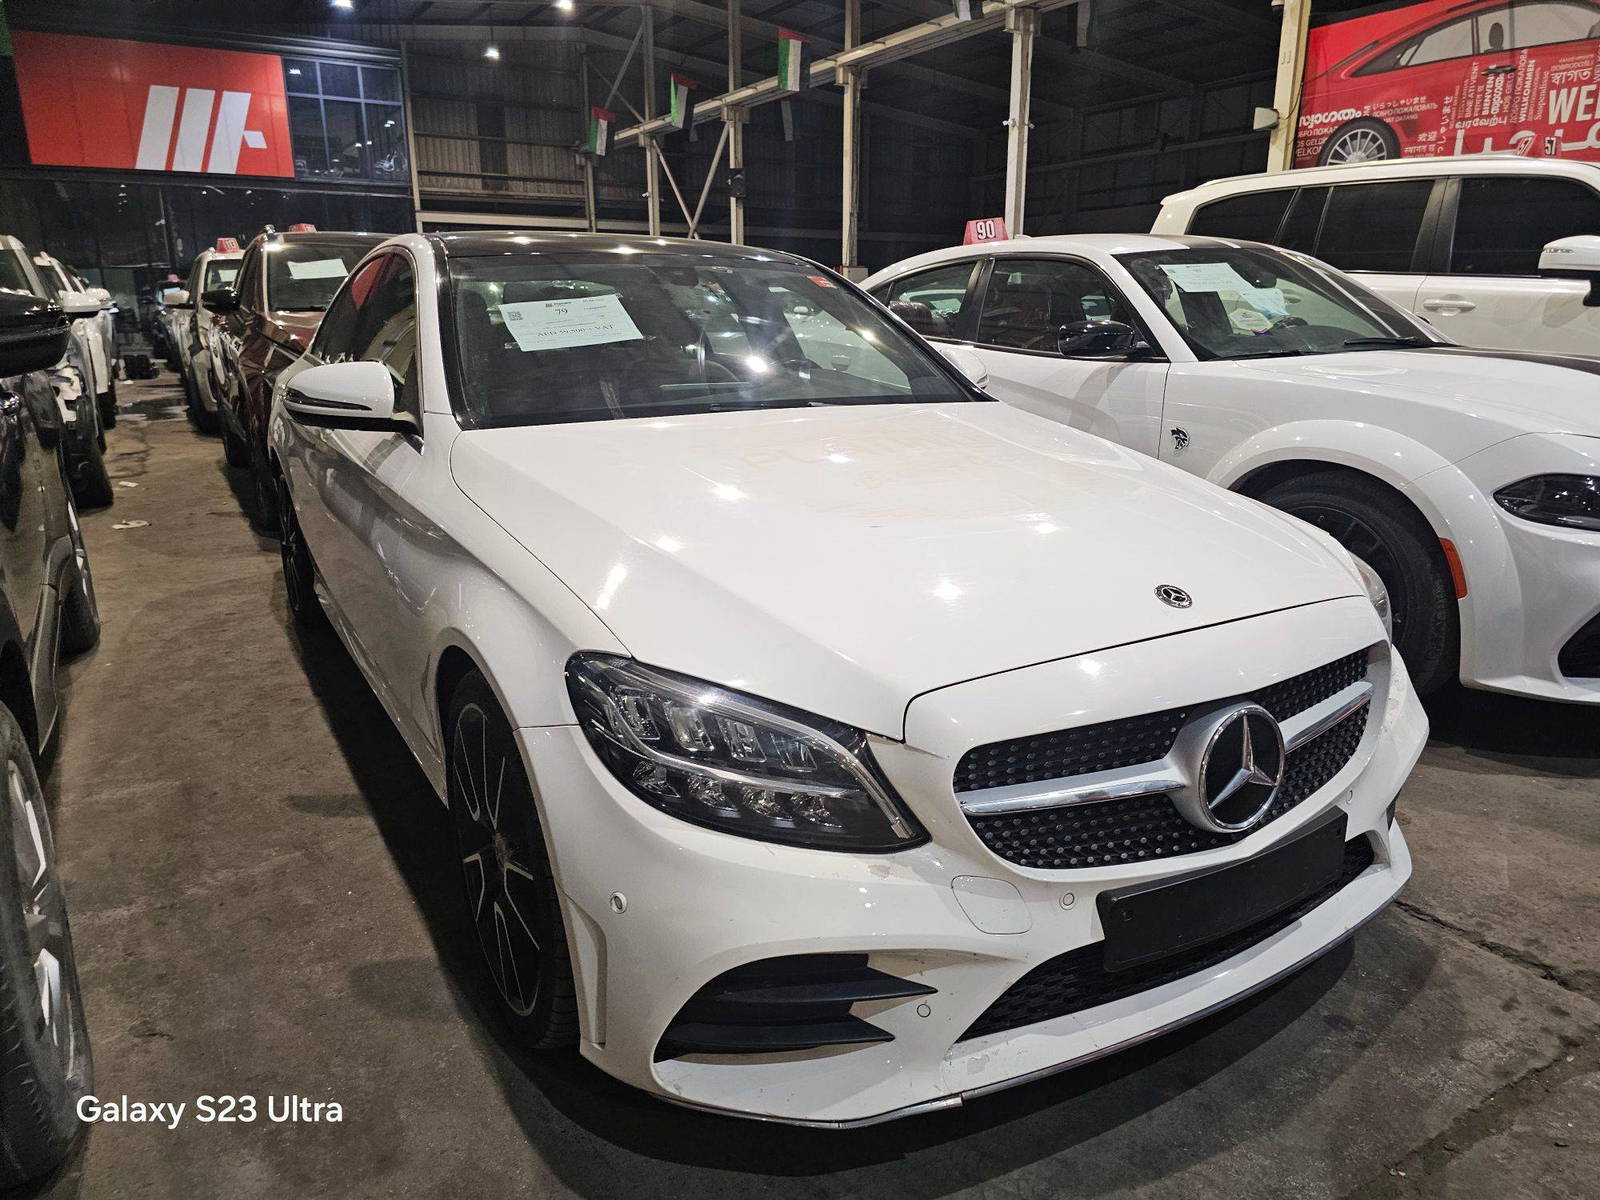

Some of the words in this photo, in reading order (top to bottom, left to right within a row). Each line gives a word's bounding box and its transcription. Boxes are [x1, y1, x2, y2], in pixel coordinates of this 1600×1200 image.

[1519, 59, 1536, 123] WILLKOMMEN
[1548, 84, 1600, 124] WE
[1544, 136, 1557, 156] 57
[976, 220, 996, 240] 90
